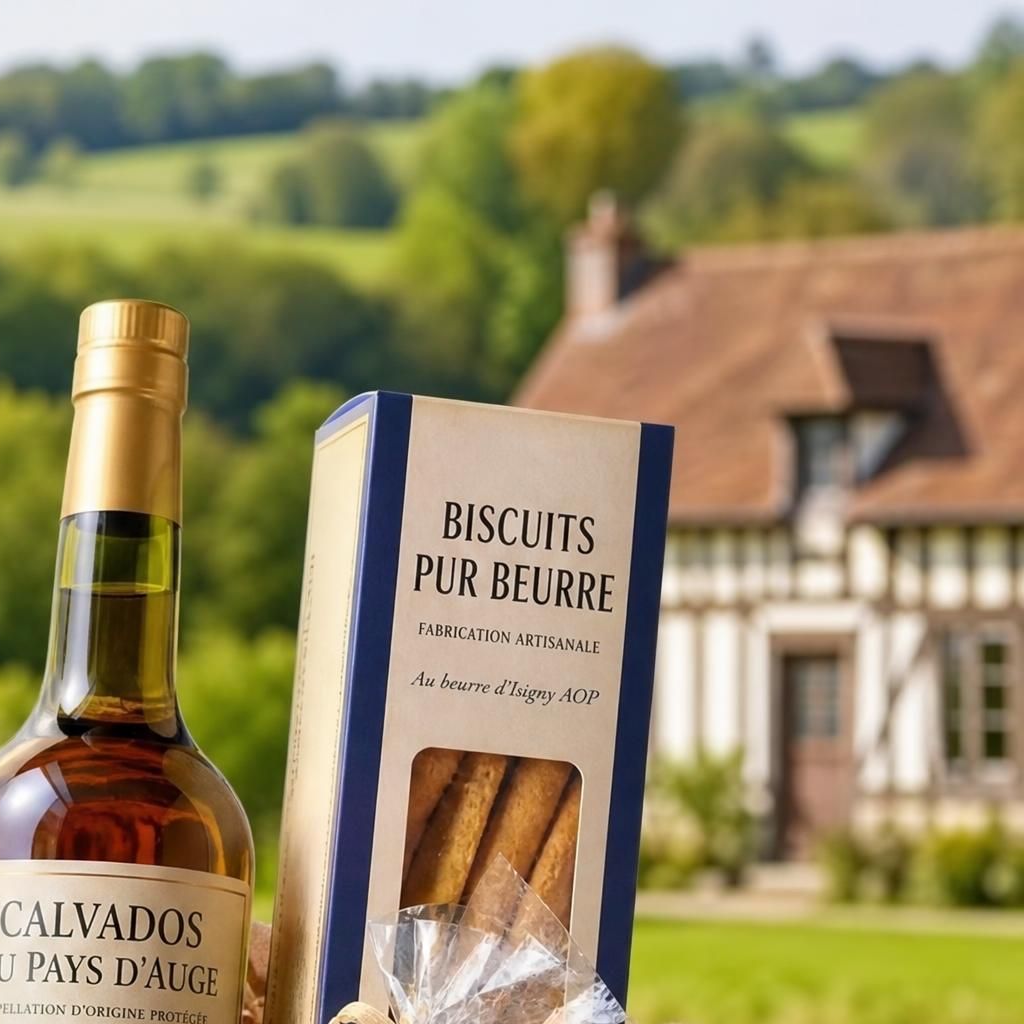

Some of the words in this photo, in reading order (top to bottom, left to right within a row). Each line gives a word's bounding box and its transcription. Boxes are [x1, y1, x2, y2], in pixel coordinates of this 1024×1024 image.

[442, 501, 595, 555] BISCUITS
[413, 554, 478, 598] PUR
[490, 562, 615, 613] BEURRE
[418, 622, 511, 644] FABRICATION
[515, 633, 600, 654] ARTISANALE
[411, 671, 435, 688] Au
[440, 673, 491, 694] beurre
[494, 679, 556, 706] d'Isigny
[559, 688, 600, 705] AOP
[0, 900, 203, 949] CALVADOS
[27, 951, 103, 986] PAYS
[115, 955, 218, 997] D'AUGE
[71, 1004, 145, 1020] D'ORIGINE
